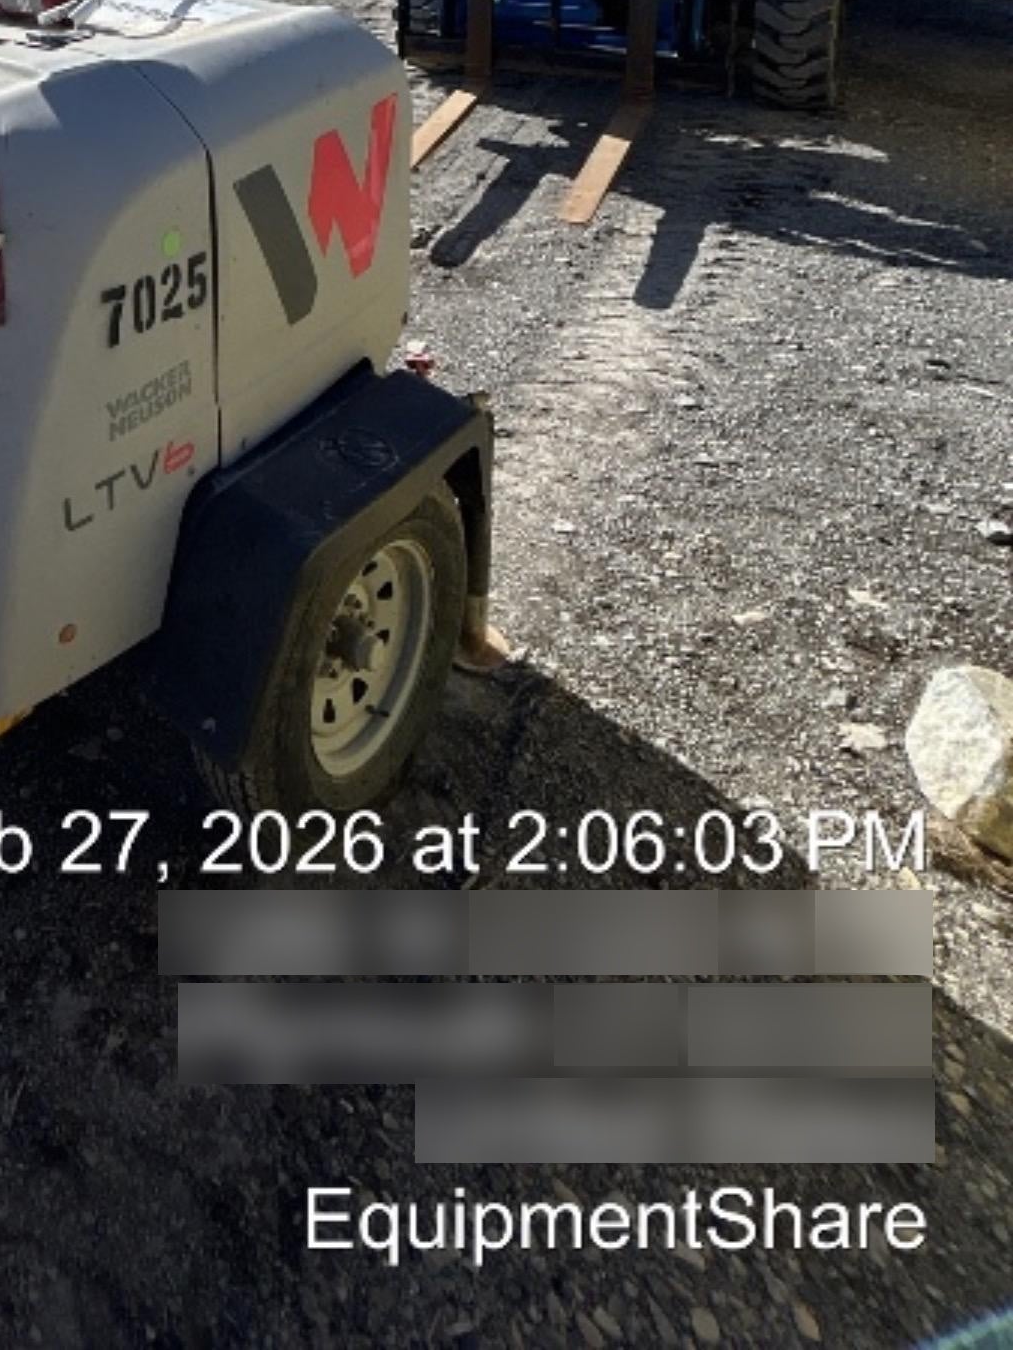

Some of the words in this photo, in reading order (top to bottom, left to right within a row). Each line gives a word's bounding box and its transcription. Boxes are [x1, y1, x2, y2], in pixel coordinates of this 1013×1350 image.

[100, 250, 208, 349] 7025
[105, 360, 192, 420] WACKER
[109, 378, 192, 442] NEUSON
[63, 441, 196, 533] LTV6
